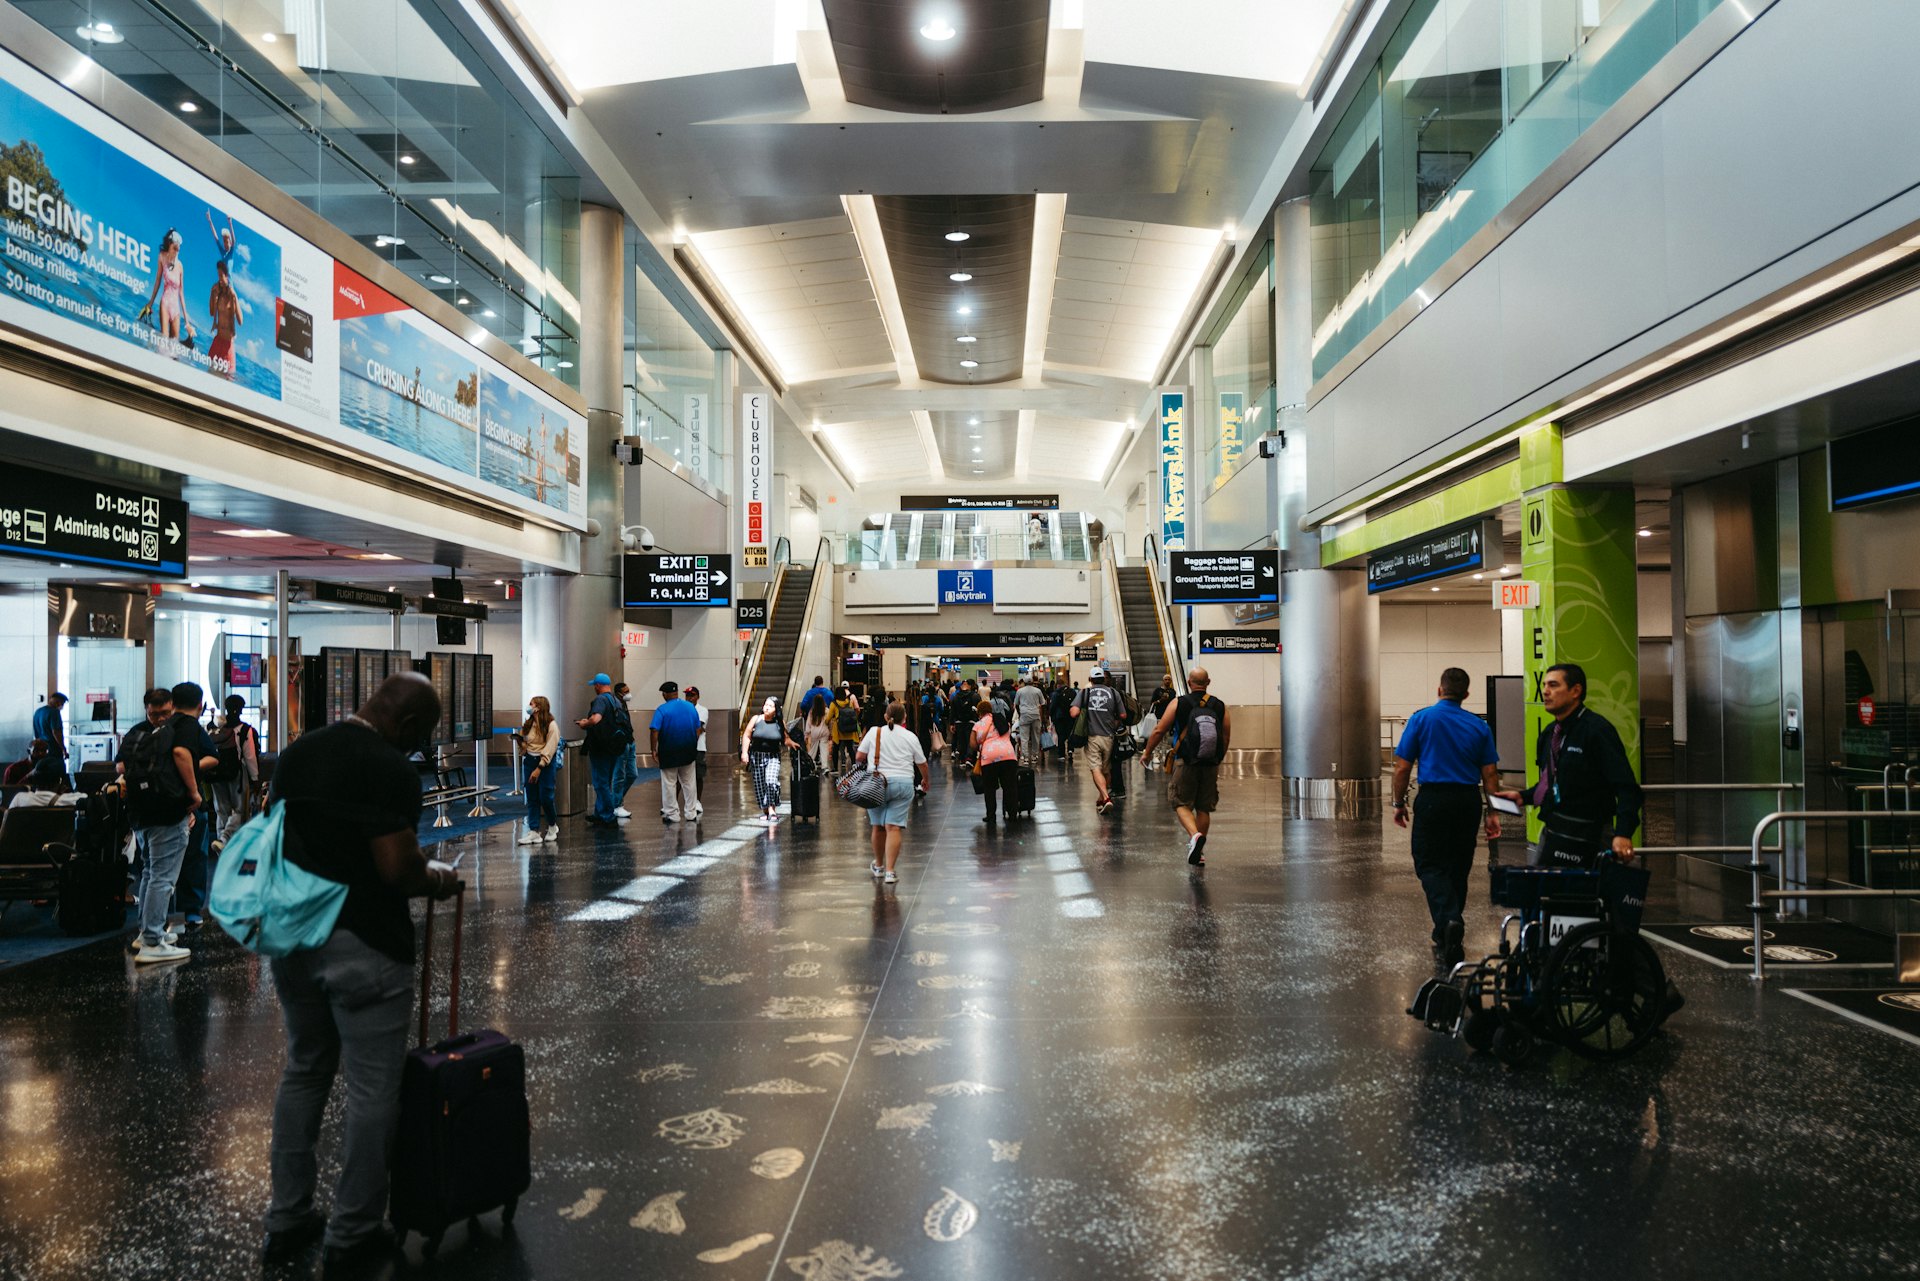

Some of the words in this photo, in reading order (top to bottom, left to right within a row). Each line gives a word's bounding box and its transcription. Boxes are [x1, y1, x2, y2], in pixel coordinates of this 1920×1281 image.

[8, 175, 94, 244] BEGINS
[98, 221, 151, 273] HERE
[7, 218, 35, 243] with
[37, 229, 79, 262] 50,000
[6, 237, 45, 269] bonus
[46, 258, 80, 285] miles.
[6, 269, 23, 291] $0
[25, 278, 54, 303] intro
[56, 294, 94, 320] annual
[96, 307, 114, 328] fee
[115, 315, 131, 334] for
[132, 322, 149, 341] the
[150, 329, 170, 349] first
[170, 338, 192, 361] year,
[193, 345, 212, 366] then
[367, 359, 414, 399] CRUISING
[415, 383, 446, 414] ALONG
[446, 399, 472, 425] THERE
[485, 419, 510, 443] BEGINS
[510, 431, 527, 453] HERE
[751, 397, 760, 500] CLUBHOUSE
[96, 493, 140, 517] D1-D25
[54, 515, 110, 540] Admirals
[112, 524, 139, 545] Club
[750, 505, 760, 541] one
[6, 529, 21, 541] D12
[128, 548, 139, 558] D15
[744, 547, 767, 555] KITCHEN
[1431, 538, 1448, 555] Terminal
[659, 556, 693, 569] EXIT
[1184, 557, 1216, 567] Baggage
[1217, 556, 1239, 565] Claim
[649, 573, 693, 583] Terminal
[961, 578, 970, 590] 2
[1175, 575, 1203, 583] Ground
[1204, 575, 1239, 584] Transport
[336, 589, 355, 600] FLIGHT
[355, 591, 387, 604] INFORMATION
[650, 589, 660, 599] F,
[661, 589, 672, 599] G,
[674, 589, 685, 599] H,
[687, 589, 693, 598] J
[955, 591, 986, 601] skytrain
[1502, 585, 1529, 605] EXIT
[740, 607, 763, 617] D25
[628, 633, 645, 645] EXIT
[739, 631, 751, 640] EXIT
[1034, 635, 1054, 643] skytrain
[1554, 850, 1583, 863] envoy
